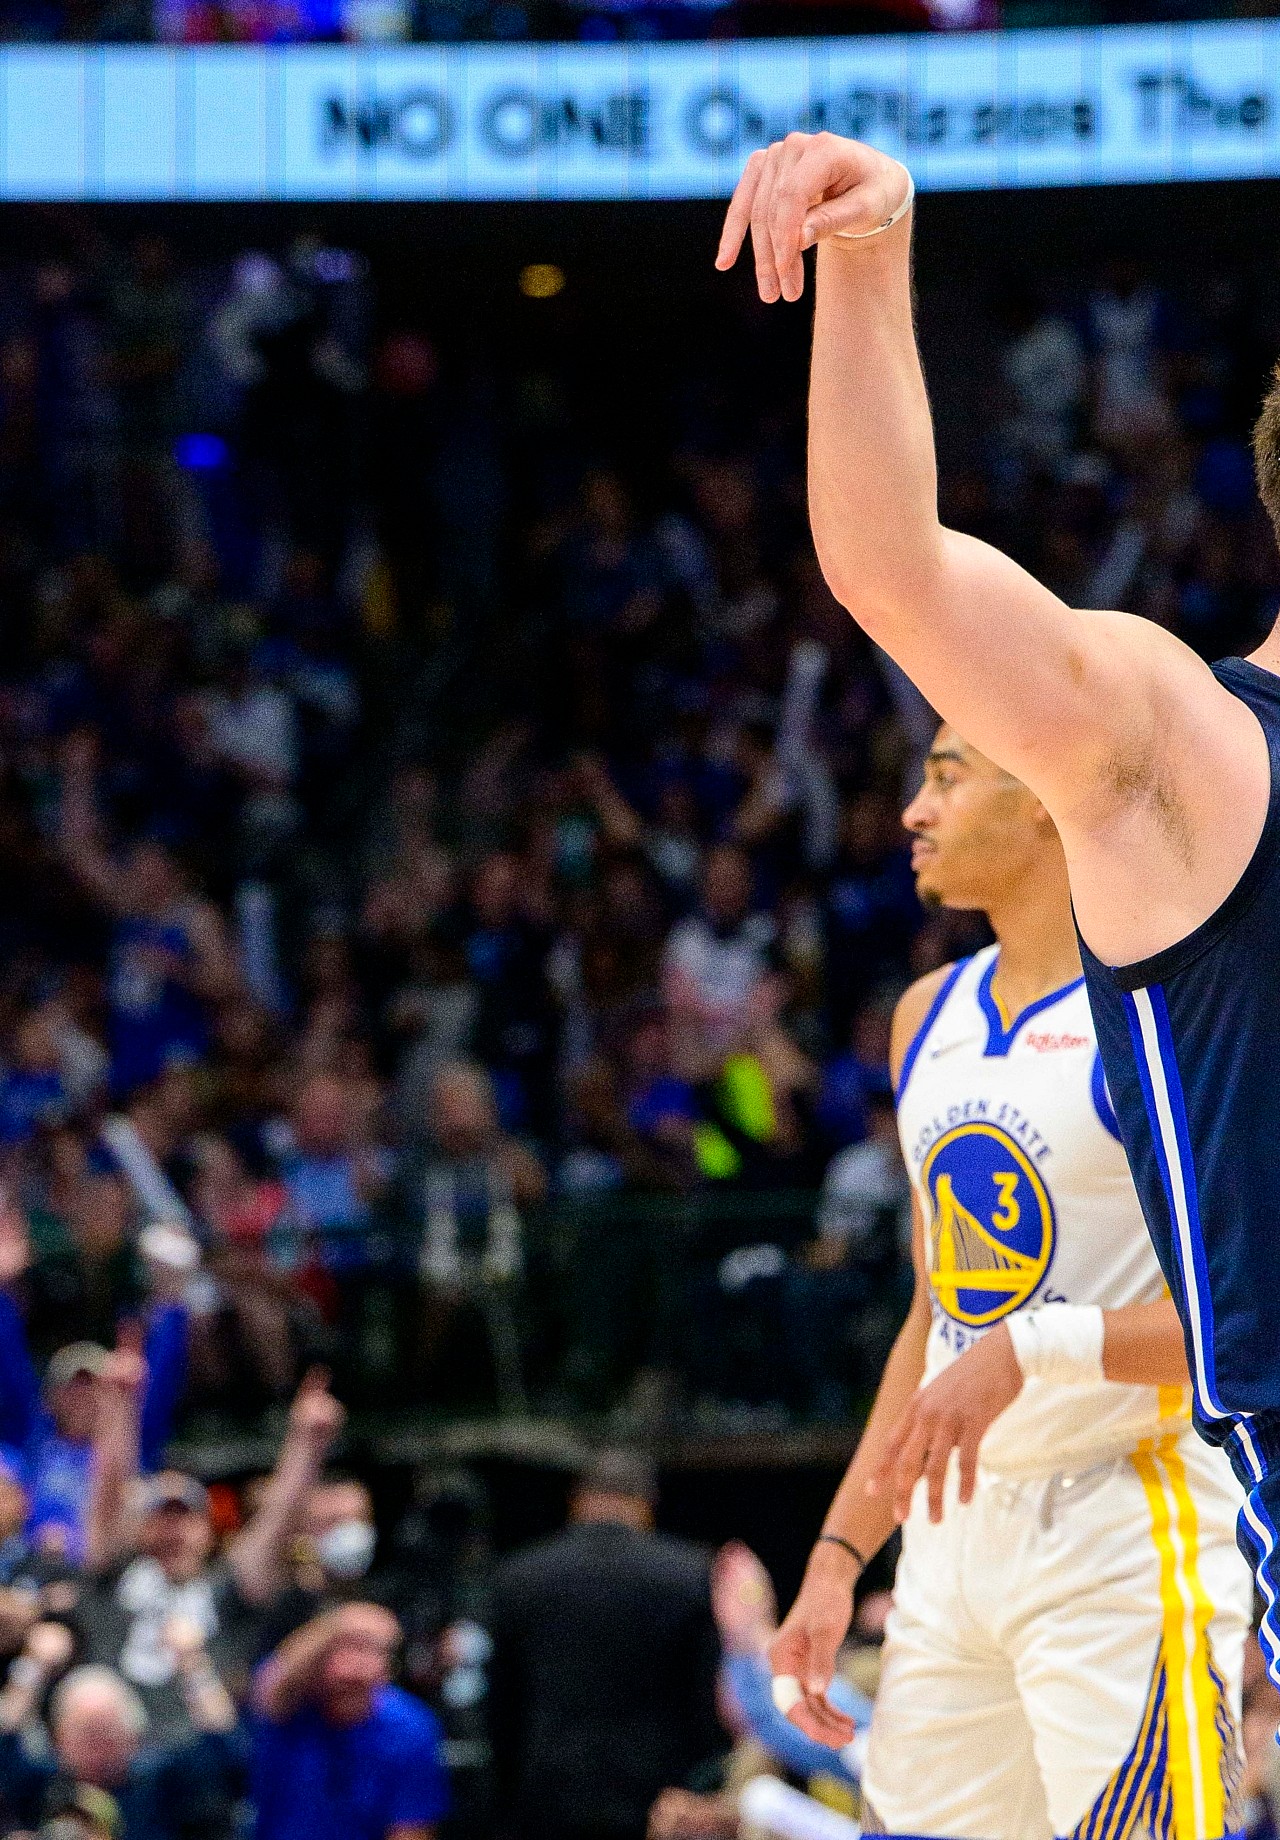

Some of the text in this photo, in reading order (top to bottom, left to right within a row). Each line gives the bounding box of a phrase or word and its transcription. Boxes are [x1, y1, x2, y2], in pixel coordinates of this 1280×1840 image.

[318, 86, 456, 158] NO
[478, 82, 652, 156] ONE
[1135, 66, 1268, 138] The
[913, 1099, 1052, 1164] GOLDEN STATE
[992, 1172, 1021, 1232] 3
